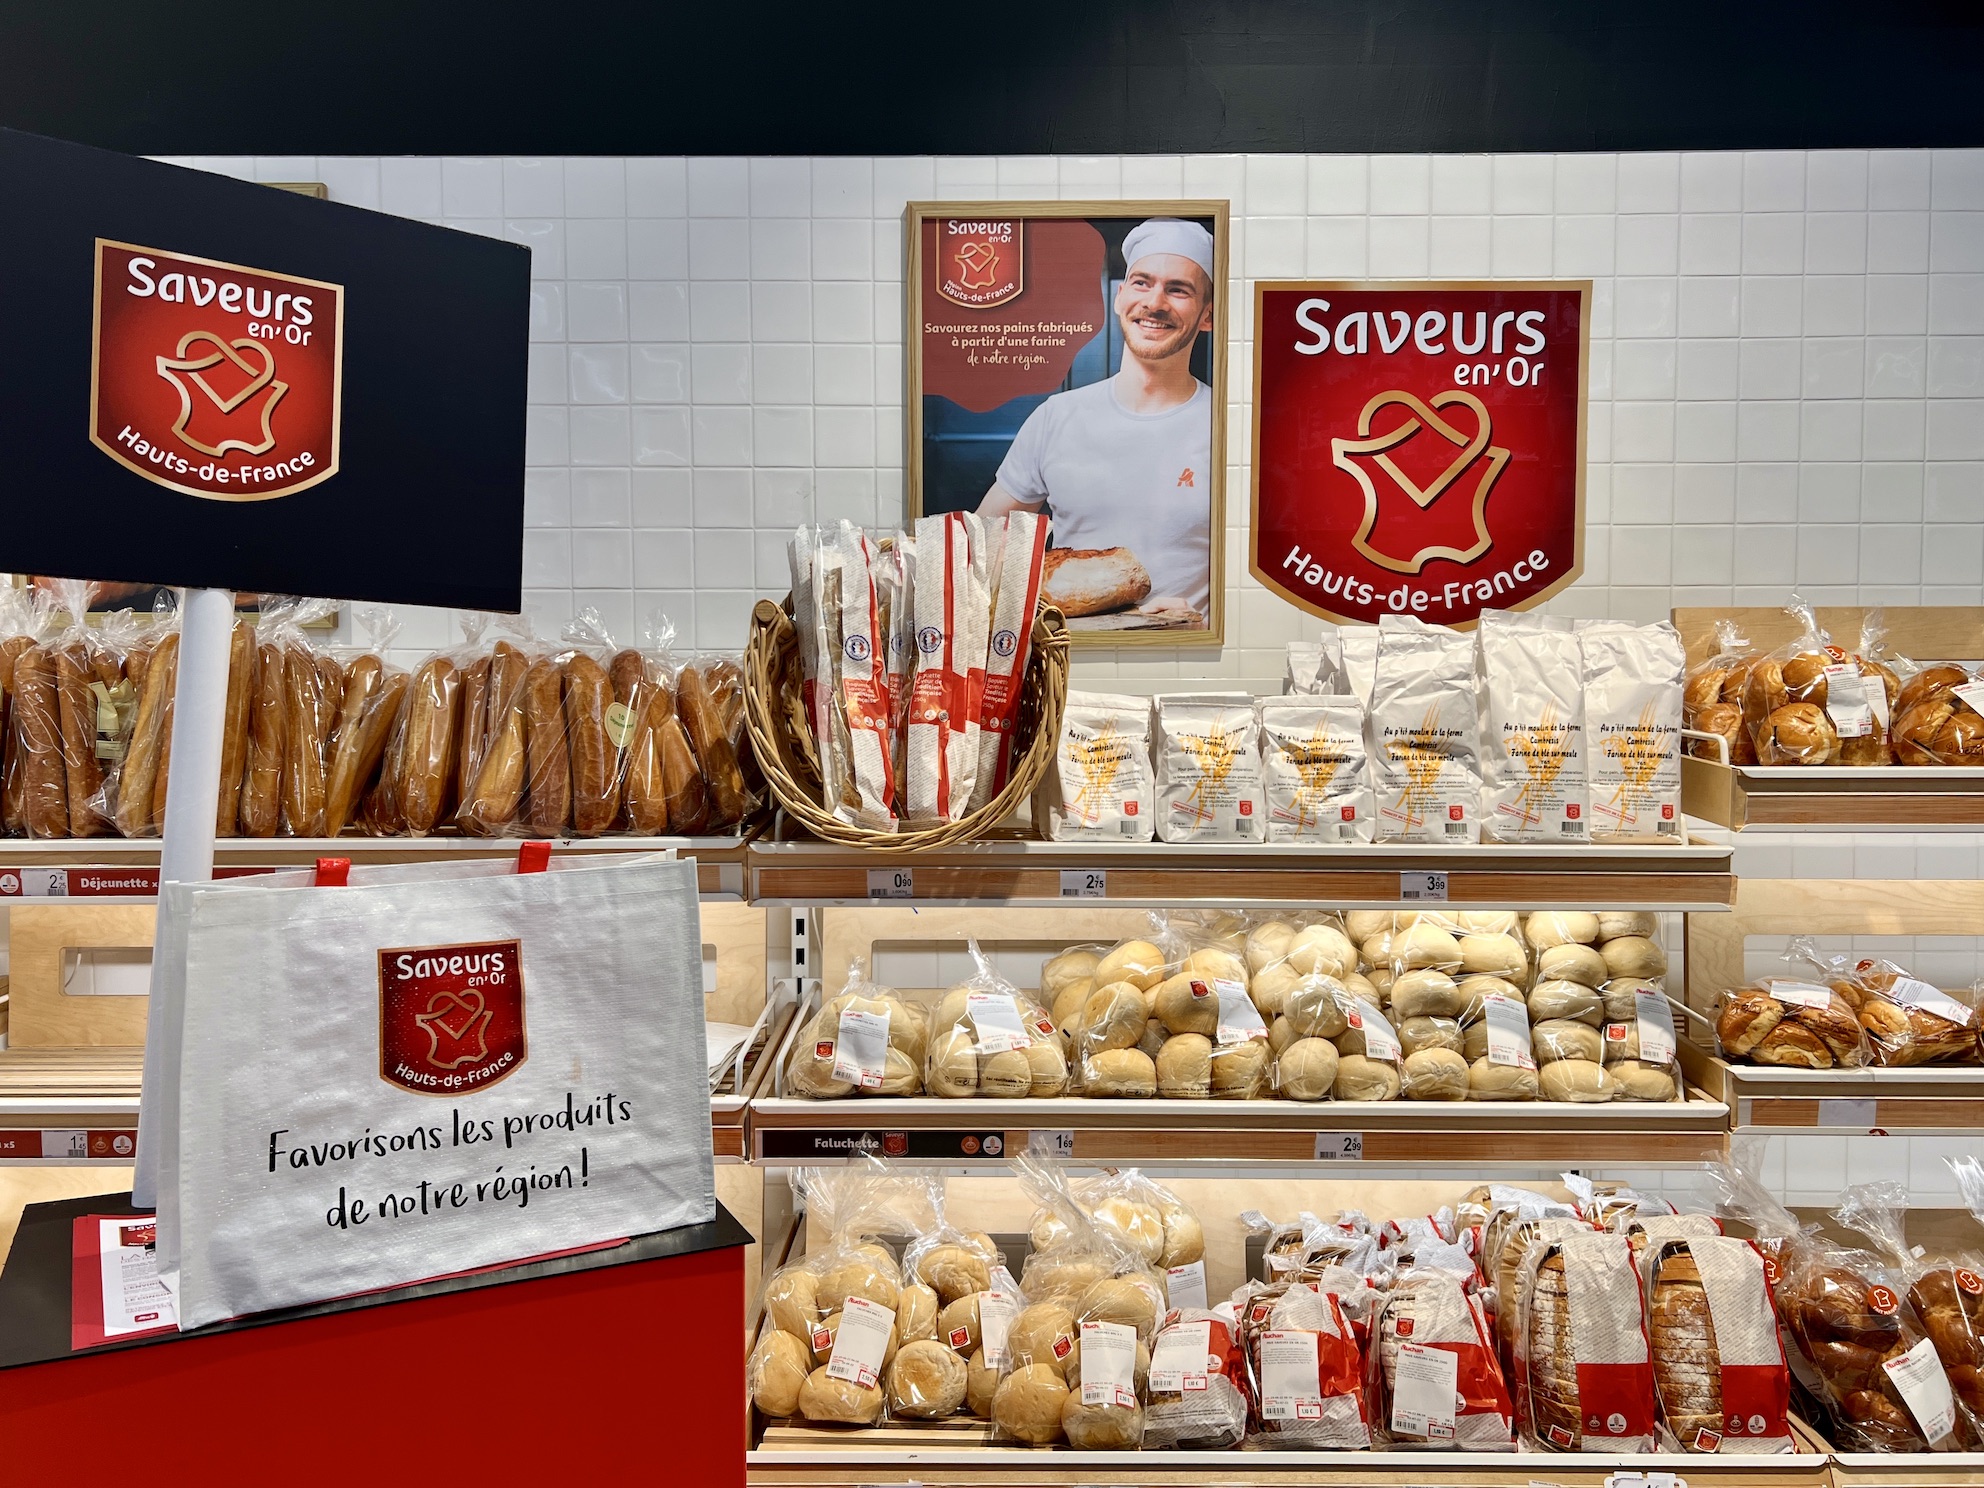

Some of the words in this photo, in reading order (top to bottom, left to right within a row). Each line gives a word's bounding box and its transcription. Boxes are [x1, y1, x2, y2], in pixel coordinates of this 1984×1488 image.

[948, 220, 1012, 235] Saveurs
[127, 257, 313, 327] Saveurs
[943, 282, 1014, 302] Hauts-de-France
[925, 324, 978, 333] Savourez
[981, 325, 1001, 333] nos
[1003, 323, 1035, 337] pains
[1038, 322, 1092, 337] fabriqués
[1294, 298, 1547, 356] Saveurs
[952, 337, 959, 347] à
[962, 337, 995, 349] partir
[997, 336, 1028, 346] d'une
[1031, 336, 1065, 346] farine
[967, 349, 979, 364] de
[983, 351, 1009, 364] notre
[1013, 354, 1049, 370] région.
[116, 424, 316, 486] Hauts-de-France
[1282, 545, 1549, 612] Hauts-de-France
[1384, 727, 1392, 736] Au
[1431, 728, 1438, 736] de
[1440, 728, 1445, 736] la
[1446, 728, 1463, 737] ferme
[1504, 722, 1512, 732] Au
[1528, 723, 1548, 731] moulin
[1550, 723, 1557, 731] de
[1567, 723, 1581, 732] ferme
[1601, 724, 1609, 732] Au
[1626, 724, 1645, 732] moulin
[1663, 725, 1677, 734] ferme
[1391, 753, 1410, 761] Farine
[1511, 749, 1530, 757] Farine
[1532, 749, 1539, 757] de
[1541, 749, 1549, 757] blé
[1561, 749, 1577, 757] meule
[1607, 750, 1626, 758] Farine
[1628, 750, 1635, 758] de
[1637, 750, 1646, 758] blé
[1657, 751, 1673, 759] meule
[81, 877, 148, 890] Déjeunette
[396, 951, 505, 981] Saveurs
[393, 1050, 514, 1088] Hauts-de-France
[268, 1125, 442, 1173] Favorisons
[452, 1108, 495, 1148] les
[503, 1092, 632, 1149] produits
[814, 1138, 879, 1149] Faluchette
[325, 1186, 371, 1231] de
[378, 1177, 469, 1219] notre
[848, 1297, 869, 1307] Auchan
[1401, 1344, 1424, 1354] Auchan
[1885, 1357, 1910, 1370] Auchan
